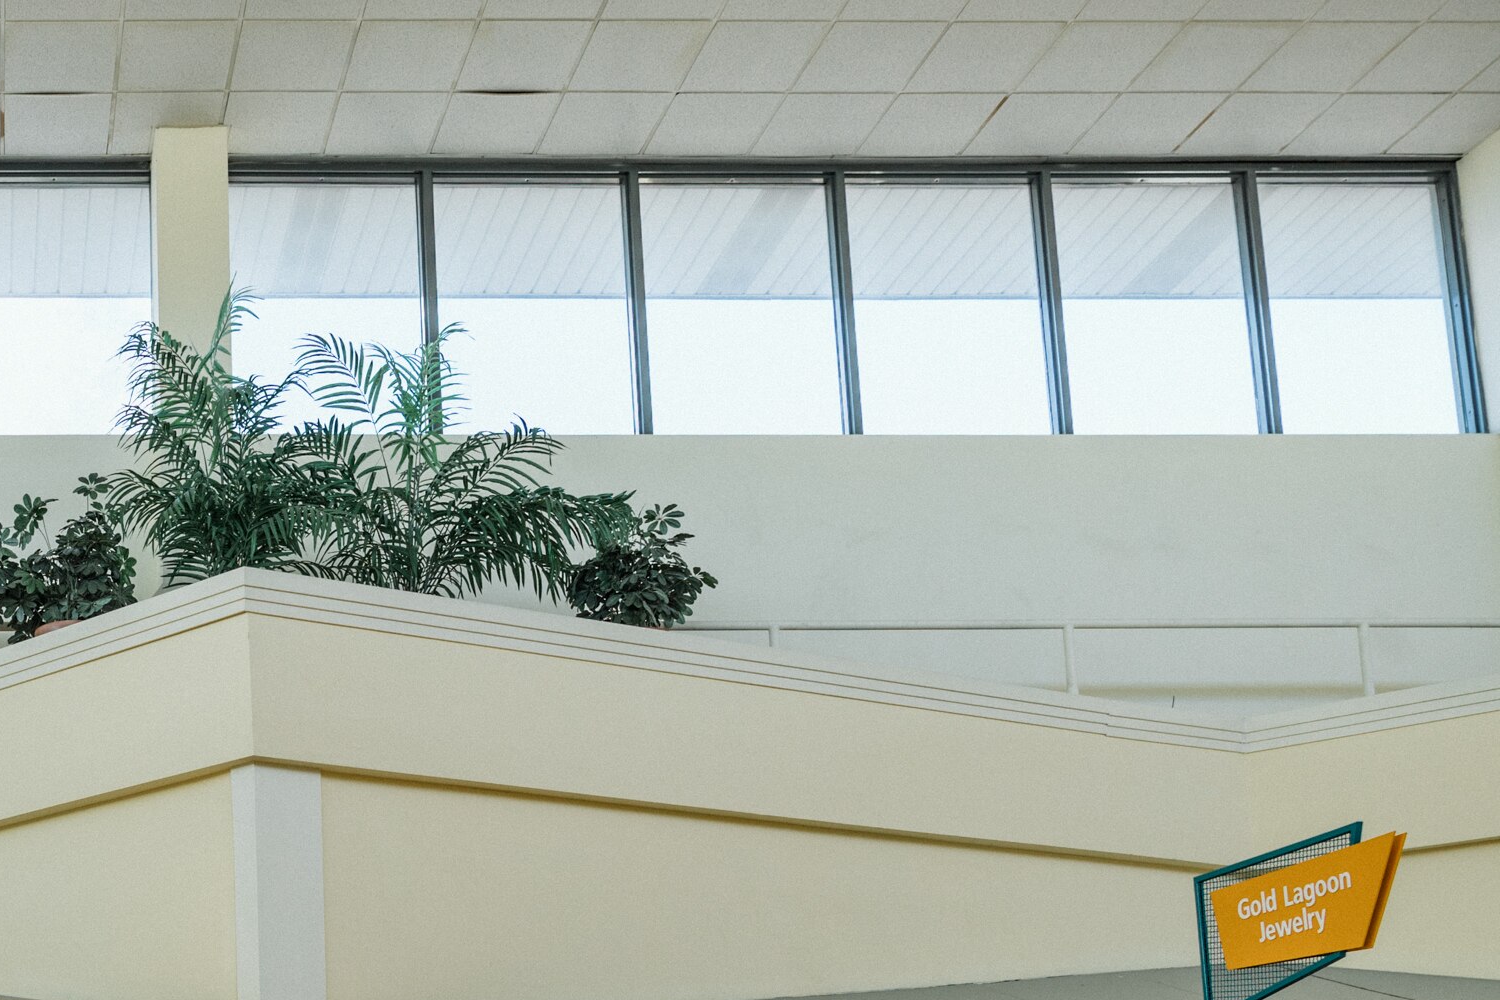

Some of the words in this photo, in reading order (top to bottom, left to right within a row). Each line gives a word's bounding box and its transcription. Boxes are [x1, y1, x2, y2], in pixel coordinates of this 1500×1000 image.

[1237, 887, 1277, 920] Gold
[1283, 871, 1352, 907] Lagoon
[1258, 908, 1326, 943] Jewelry
